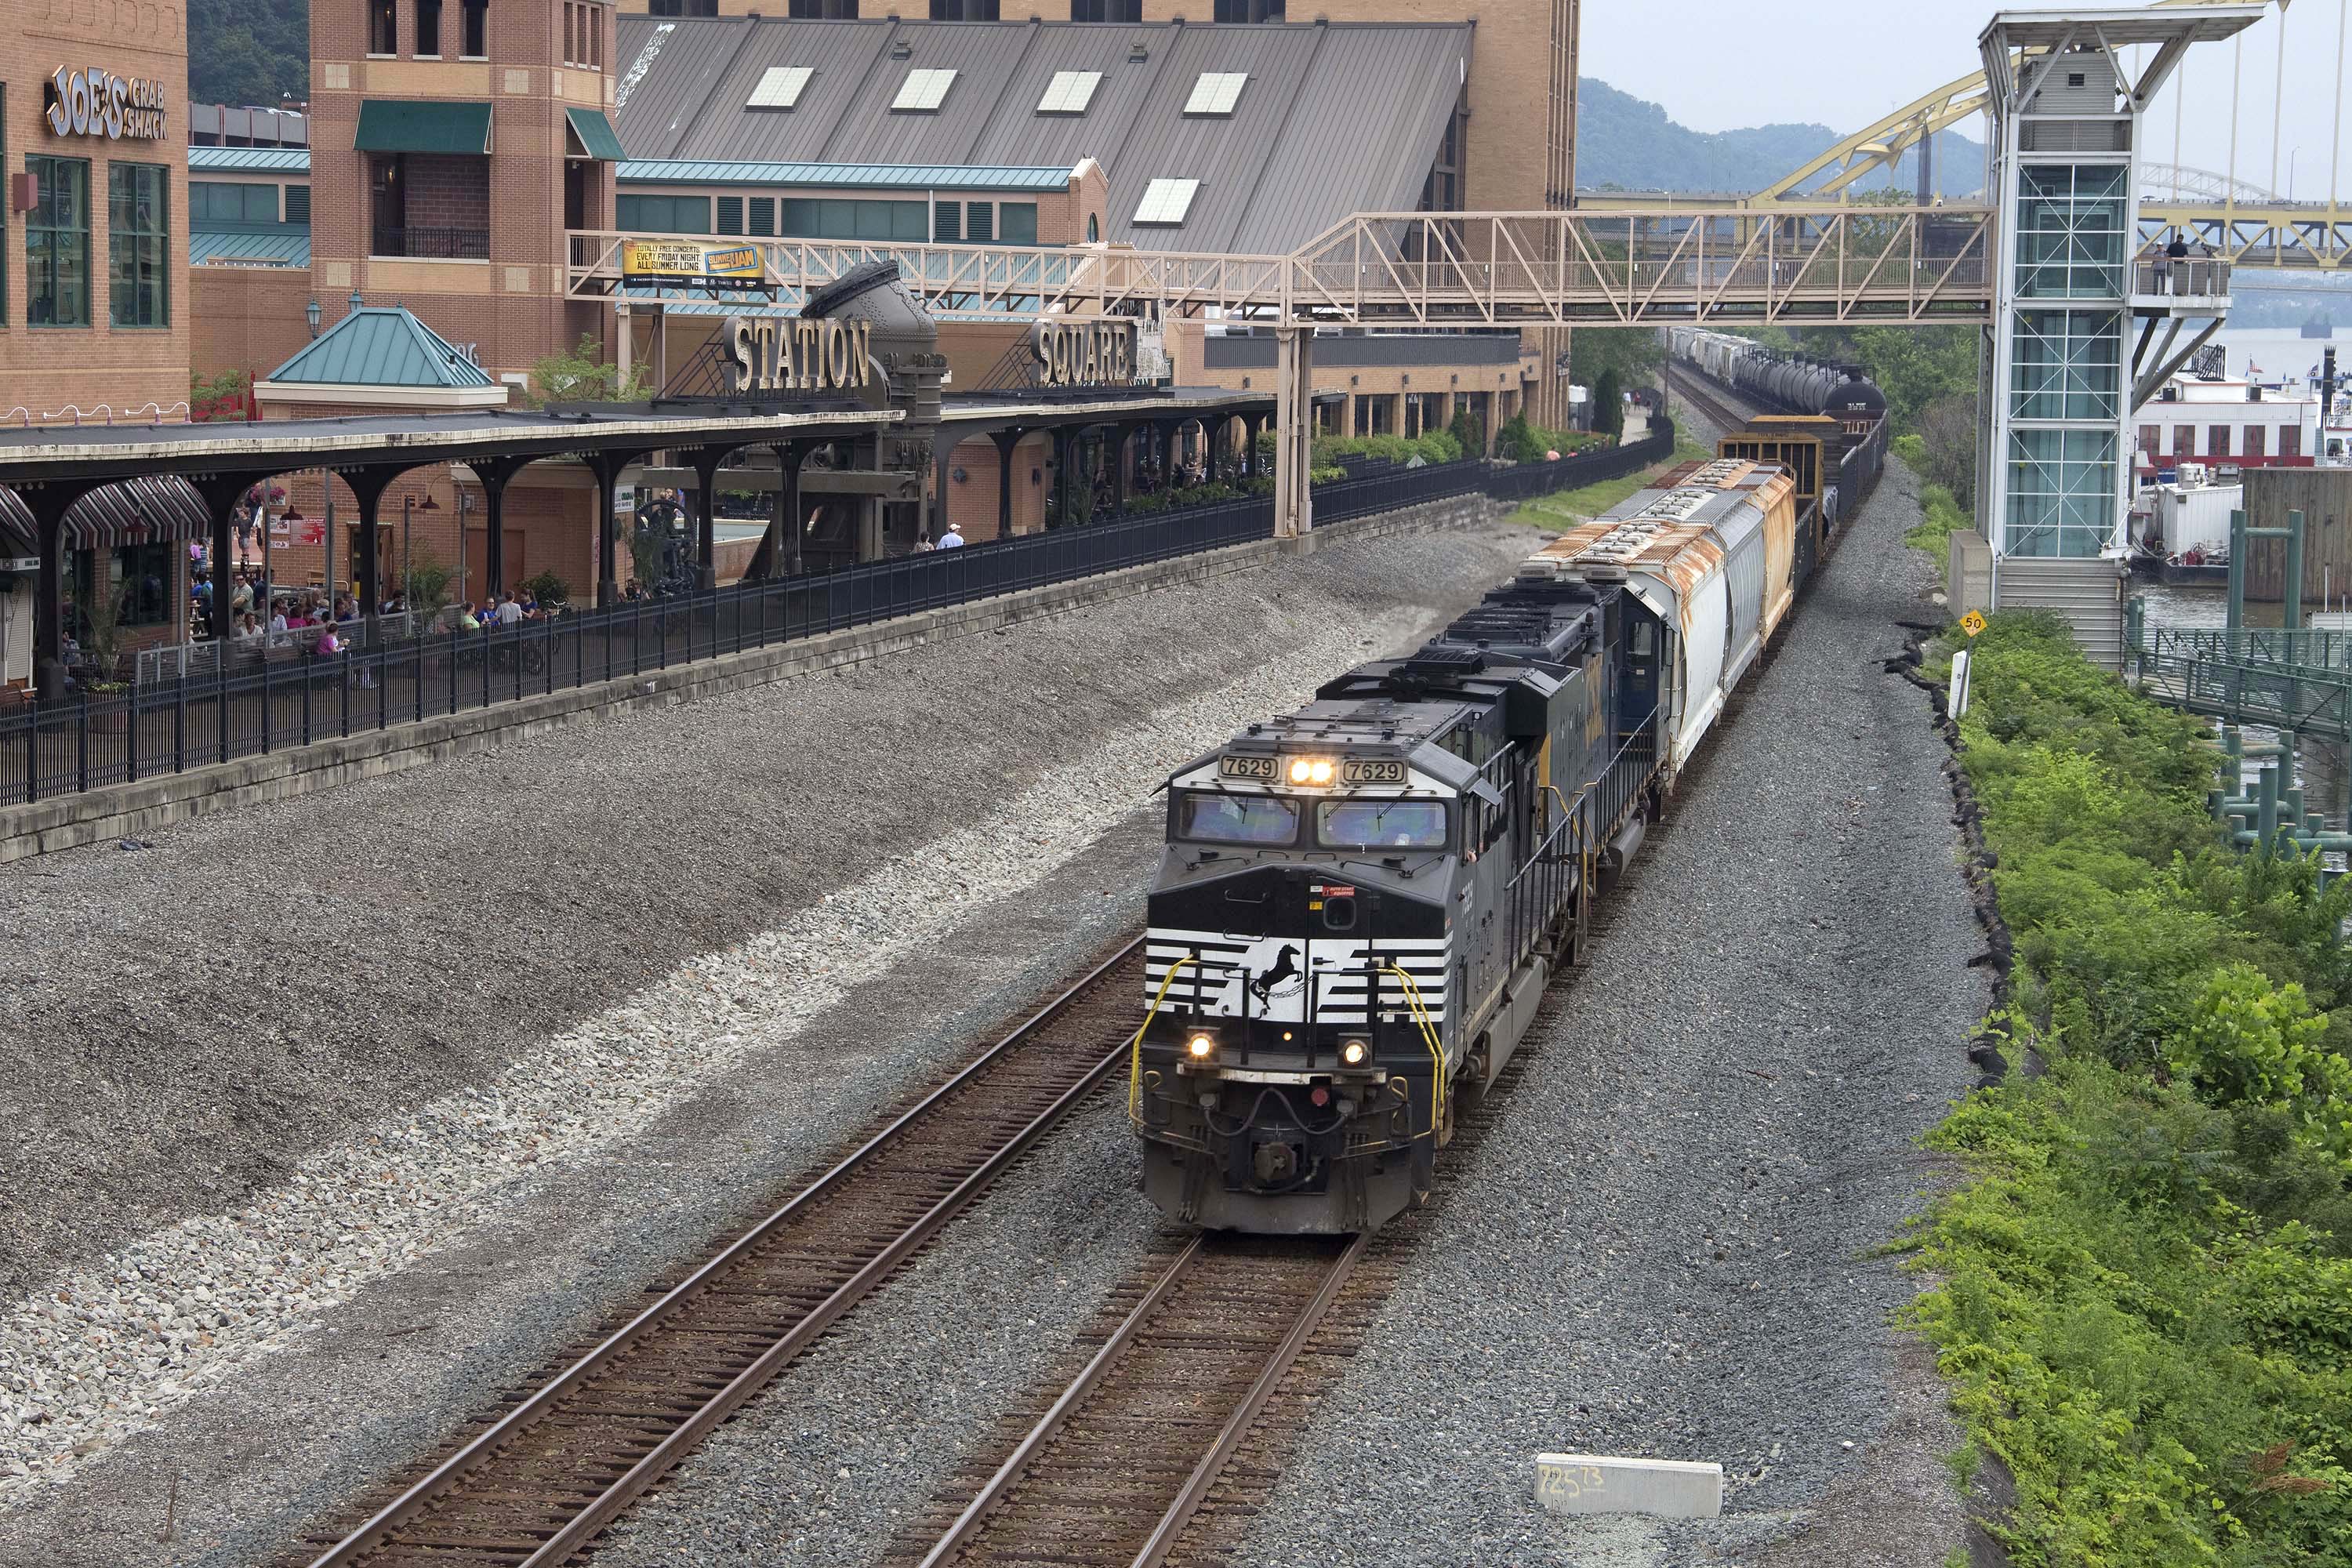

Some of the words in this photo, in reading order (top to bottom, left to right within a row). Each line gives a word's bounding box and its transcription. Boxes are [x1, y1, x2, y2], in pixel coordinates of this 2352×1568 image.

[46, 64, 129, 140] JOE'S
[129, 77, 165, 110] CRAB
[123, 107, 169, 140] SHACK
[637, 261, 650, 270] ALL
[652, 261, 678, 270] SUMMER
[680, 262, 701, 271] LONG.
[658, 252, 679, 261] FRIDAY
[680, 253, 701, 262] NIGHT.
[733, 249, 755, 267] JAM
[734, 317, 871, 391] STATION
[1039, 324, 1128, 384] SQUARE
[1965, 617, 1981, 629] 50
[1225, 758, 1272, 776] 7629
[1348, 763, 1399, 780] 7629
